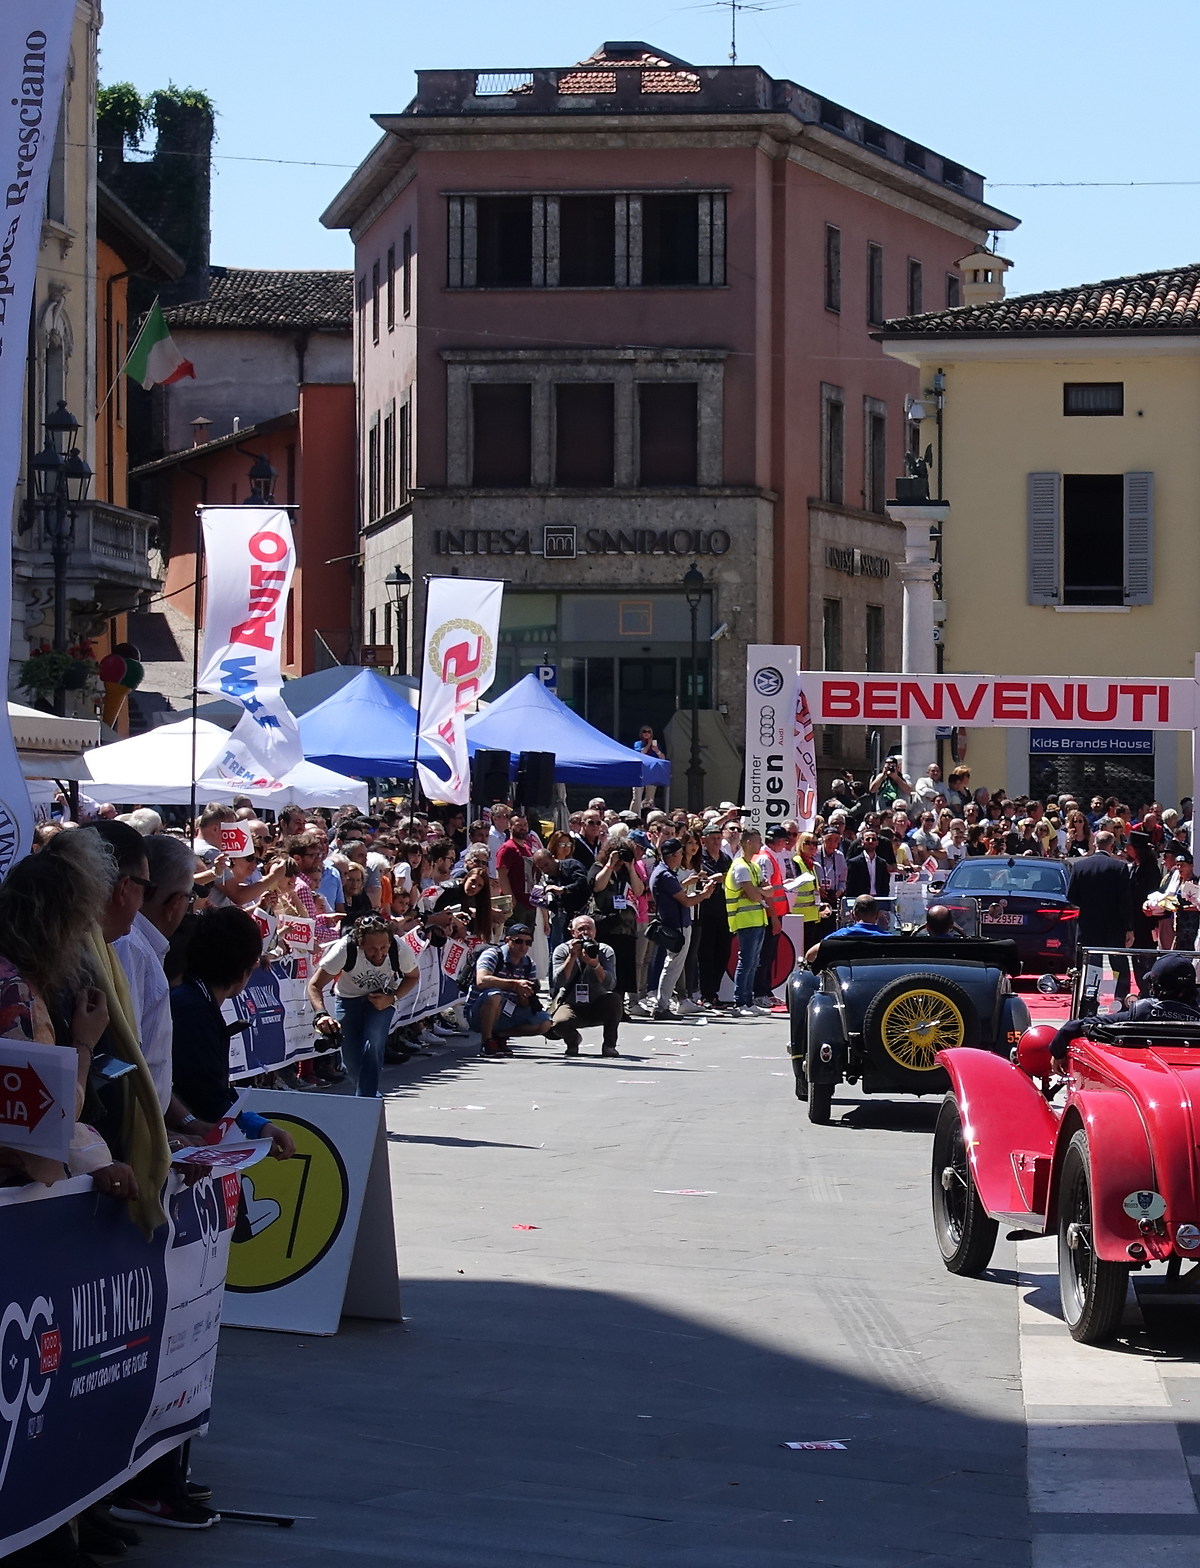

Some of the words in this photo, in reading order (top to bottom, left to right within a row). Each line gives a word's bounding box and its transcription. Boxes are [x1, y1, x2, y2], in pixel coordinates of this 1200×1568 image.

[6, 29, 47, 210] Bresciano
[0, 214, 20, 325] poca
[434, 529, 531, 555] INTESA
[586, 529, 731, 555] SANPAOLO
[229, 531, 287, 651] AUTO
[539, 667, 554, 683] P
[822, 681, 1169, 722] BENVENUTI
[222, 751, 255, 780] TREM
[1032, 738, 1059, 748] Kids
[1061, 739, 1108, 749] Brands
[1110, 740, 1151, 749] House
[750, 755, 764, 802] partner
[765, 754, 790, 840] gen
[1007, 1031, 1021, 1044] 55
[71, 1278, 108, 1351] MILLE
[111, 1266, 152, 1337] MIGLIA
